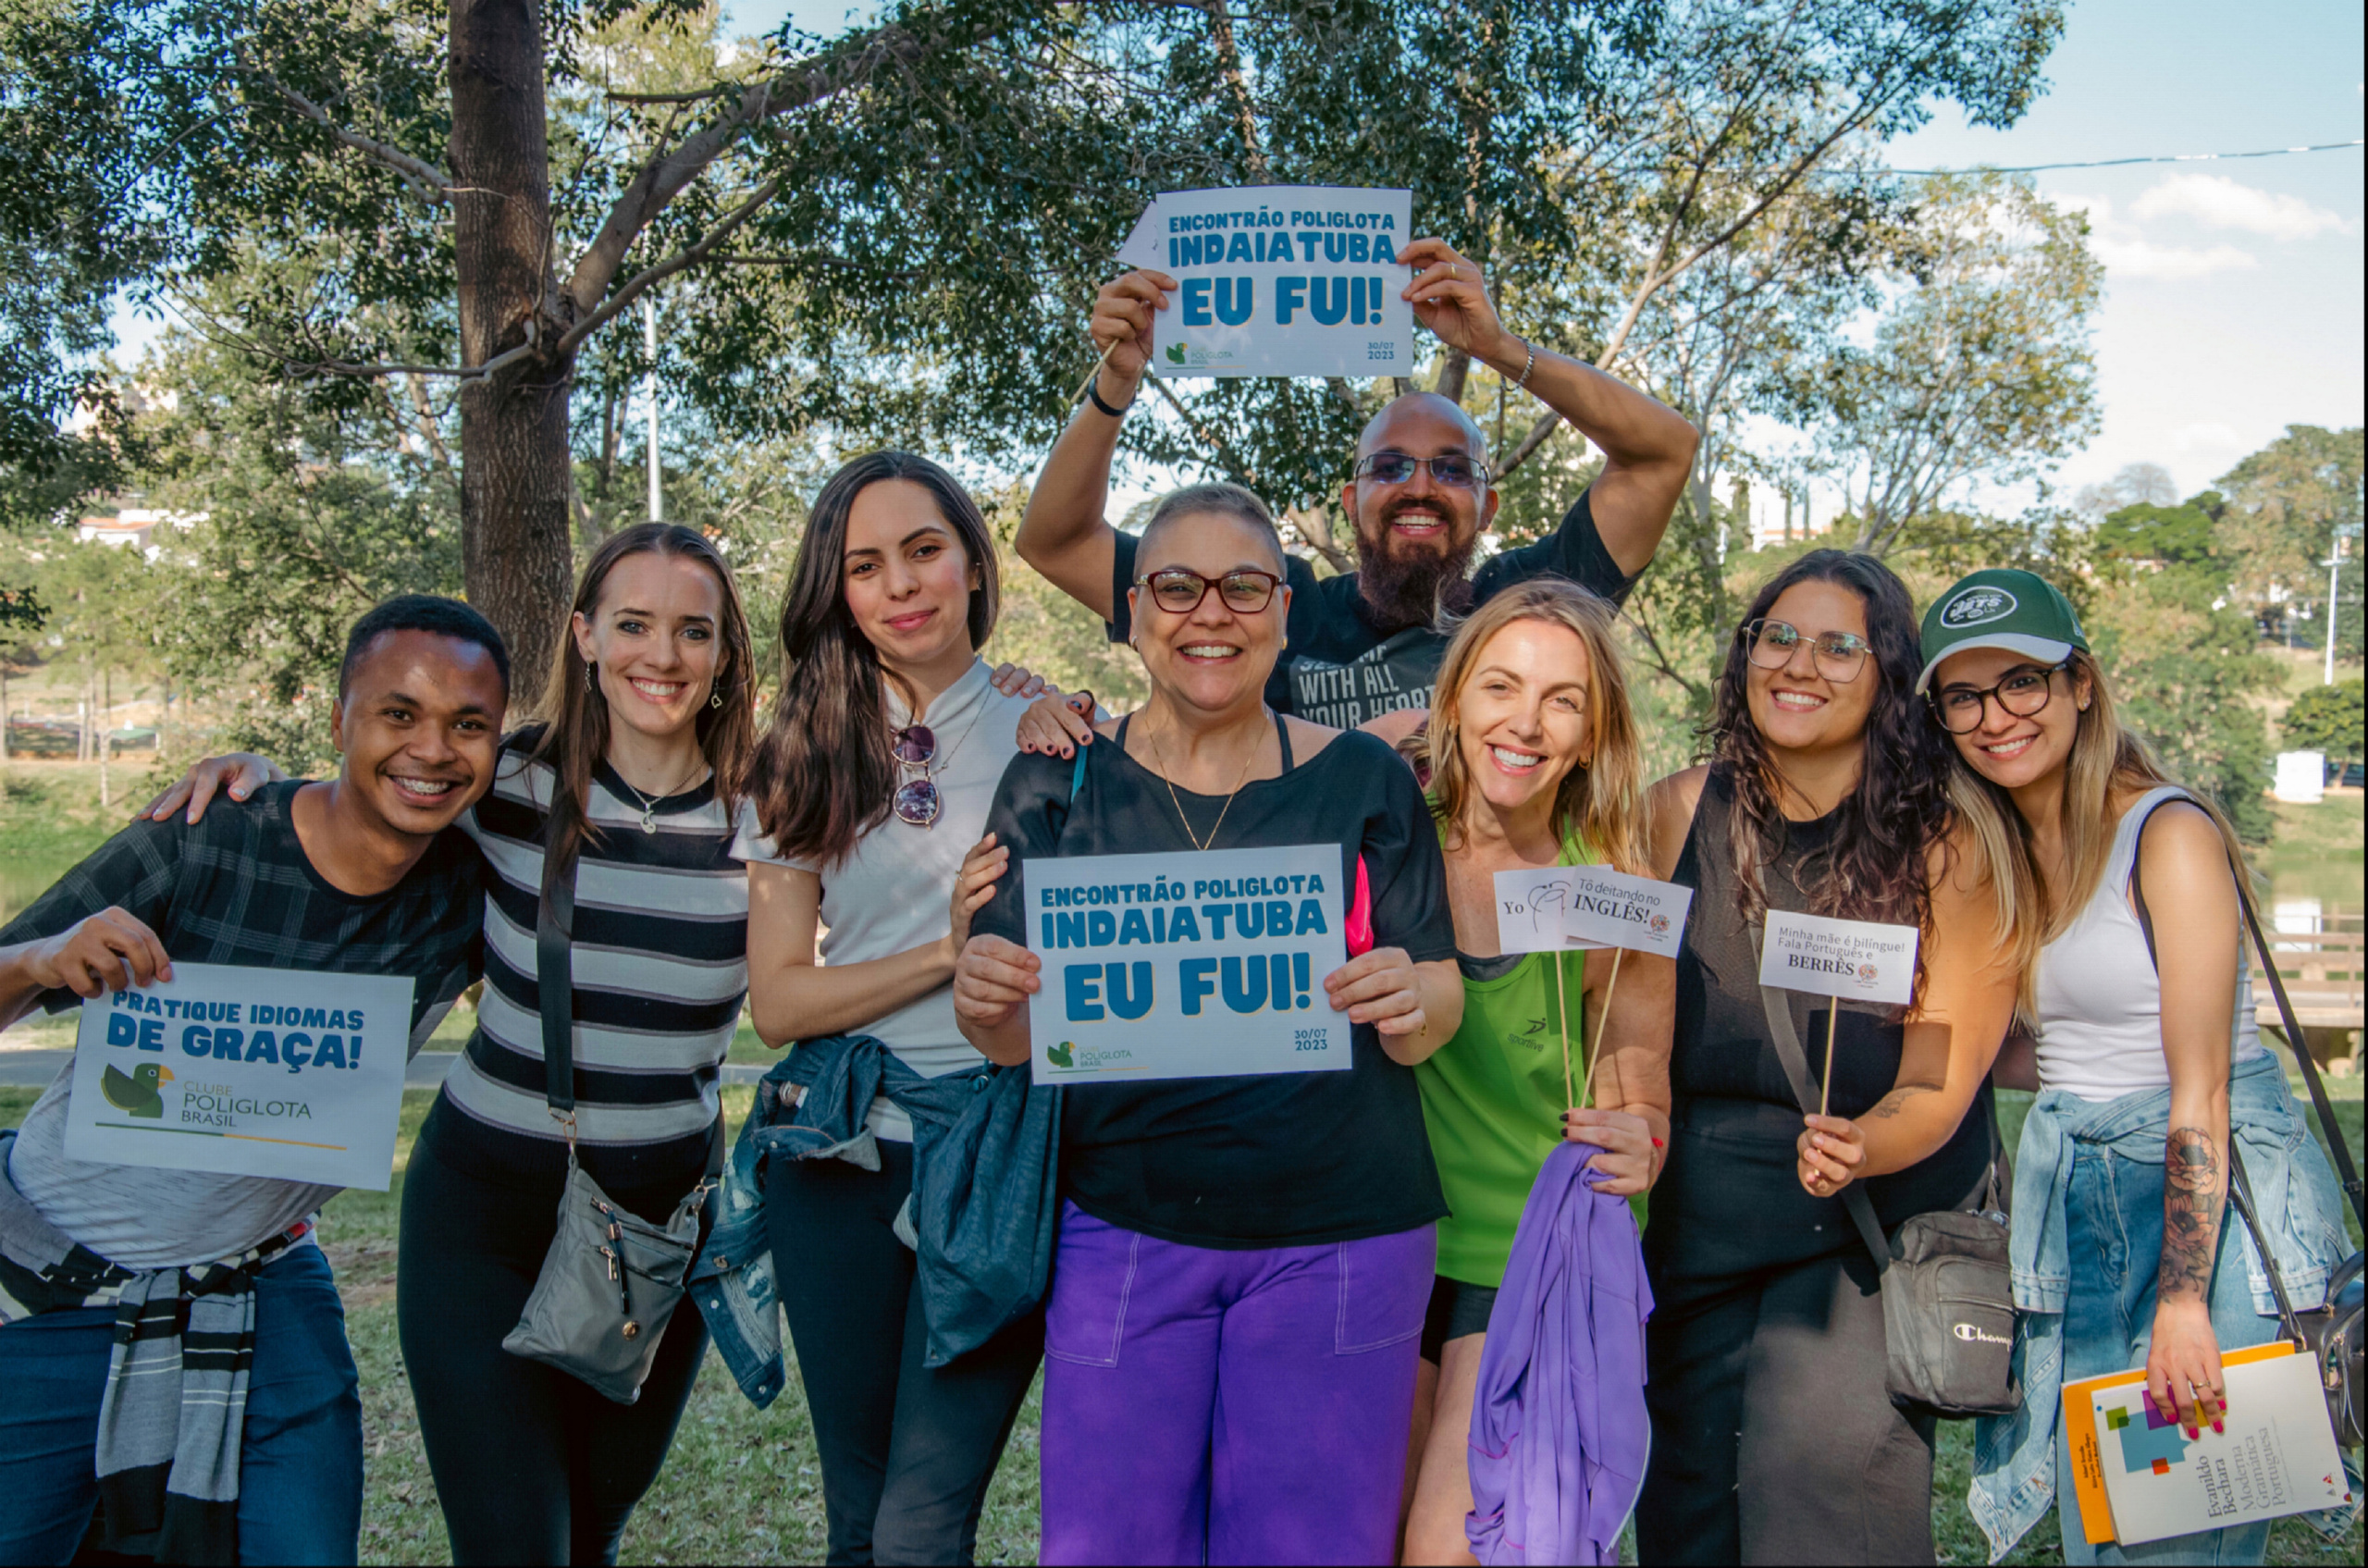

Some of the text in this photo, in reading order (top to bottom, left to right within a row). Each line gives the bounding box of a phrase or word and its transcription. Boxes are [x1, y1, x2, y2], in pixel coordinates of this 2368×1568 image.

[1169, 205, 1395, 232] ENCONTRÃO POLIGLOTA
[1168, 232, 1397, 267] INDAIATUBA
[1182, 277, 1385, 327] EU FUI!
[1367, 341, 1394, 350] 30/07
[1367, 351, 1395, 360] 2023
[1299, 663, 1400, 705] WITH ALL
[1042, 874, 1325, 907] ENCONTRÃO POLIGLOTA
[1579, 878, 1660, 906] Tô deitando no
[1503, 901, 1524, 915] Yo
[1573, 894, 1650, 924] INGLÊS!
[1042, 898, 1328, 949] INDAIATUBA
[1778, 937, 1873, 959] Fala Português e
[1779, 926, 1906, 953] Minha mãe é bilíngue!
[1788, 954, 1855, 976] BERRÊS
[1064, 952, 1314, 1022] EU FUI!
[112, 990, 364, 1031] PRATIQUE IDIOMAS
[106, 1012, 363, 1074] DE GRAÇA!
[1295, 1029, 1327, 1039] 30/07
[1295, 1040, 1328, 1051] 2023
[1080, 1050, 1132, 1060] POLIGLOTA
[184, 1081, 232, 1096] CLUBE
[181, 1110, 238, 1128] BRASIL
[184, 1093, 313, 1119] POLIGLOTA
[2232, 1445, 2257, 1511] Moderna
[2244, 1436, 2271, 1509] Gramática
[2258, 1426, 2287, 1506] Portuguesa
[2196, 1455, 2223, 1518] Evanildo
[2215, 1458, 2238, 1515] Bechara
